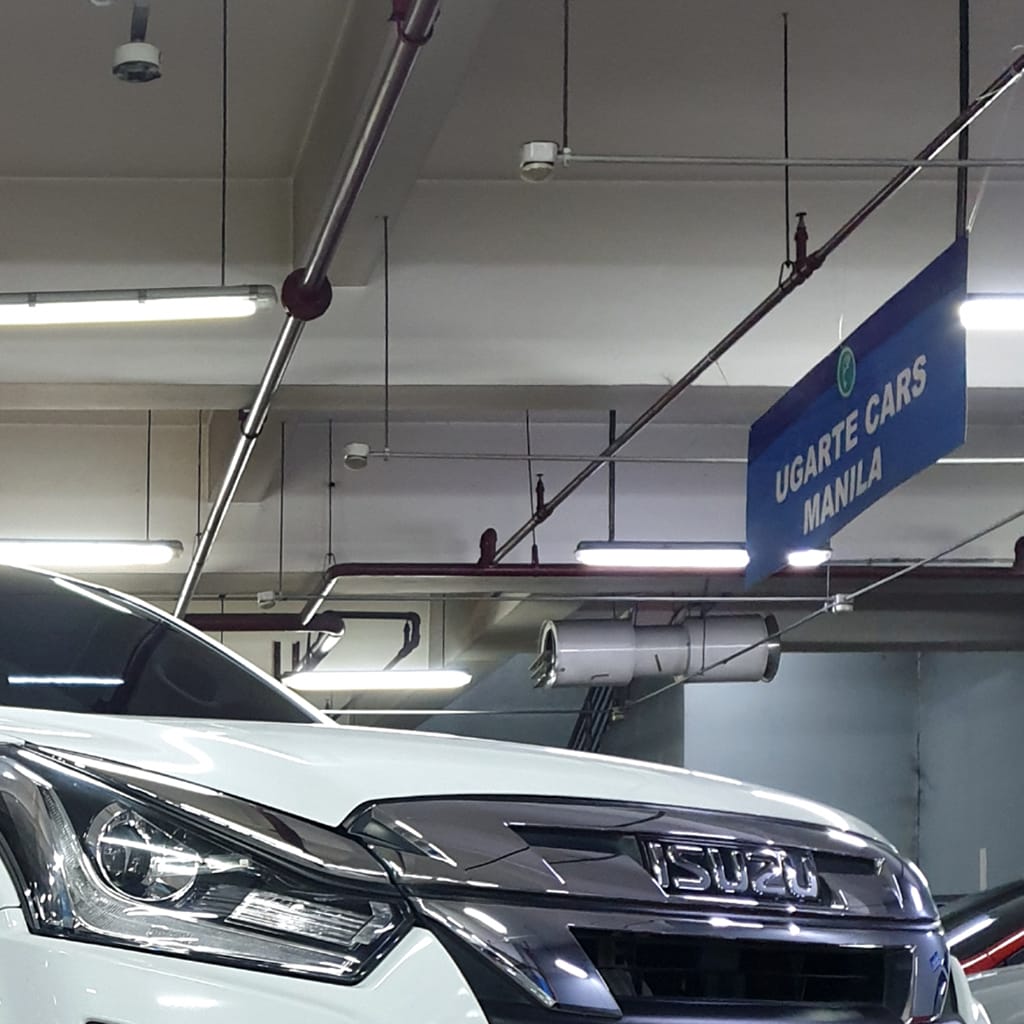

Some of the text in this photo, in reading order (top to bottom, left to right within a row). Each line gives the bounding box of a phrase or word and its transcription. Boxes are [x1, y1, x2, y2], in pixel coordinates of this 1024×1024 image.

[776, 354, 926, 503] UGARTE CARS
[803, 446, 882, 535] MANILA
[648, 841, 818, 898] ISUZU
